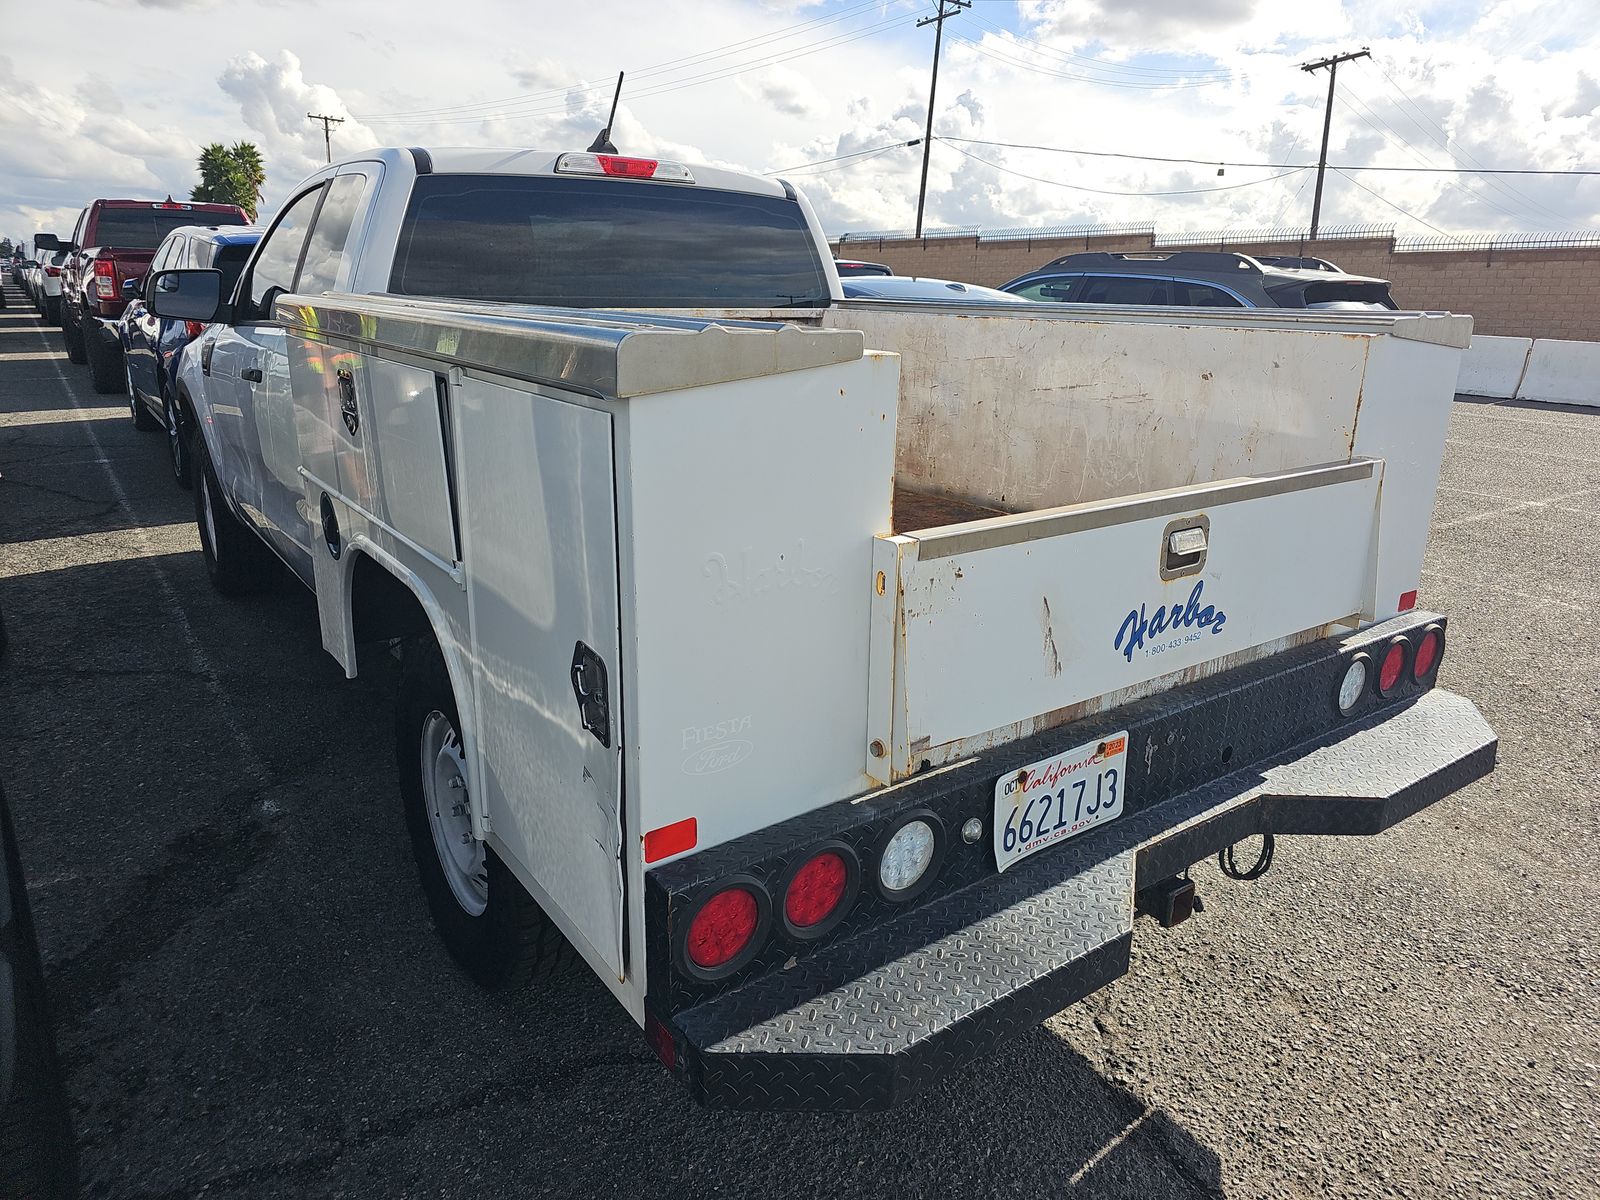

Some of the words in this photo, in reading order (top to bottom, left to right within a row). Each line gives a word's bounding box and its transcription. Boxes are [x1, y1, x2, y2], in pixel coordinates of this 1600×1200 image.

[1114, 580, 1227, 663] Harbor
[681, 714, 753, 750] FIESTA
[695, 743, 744, 772] Ford
[1021, 751, 1104, 794] California
[1004, 778, 1019, 796] OCT
[1003, 768, 1118, 852] 66217J3
[1024, 817, 1092, 851] dmv.ca.gov
